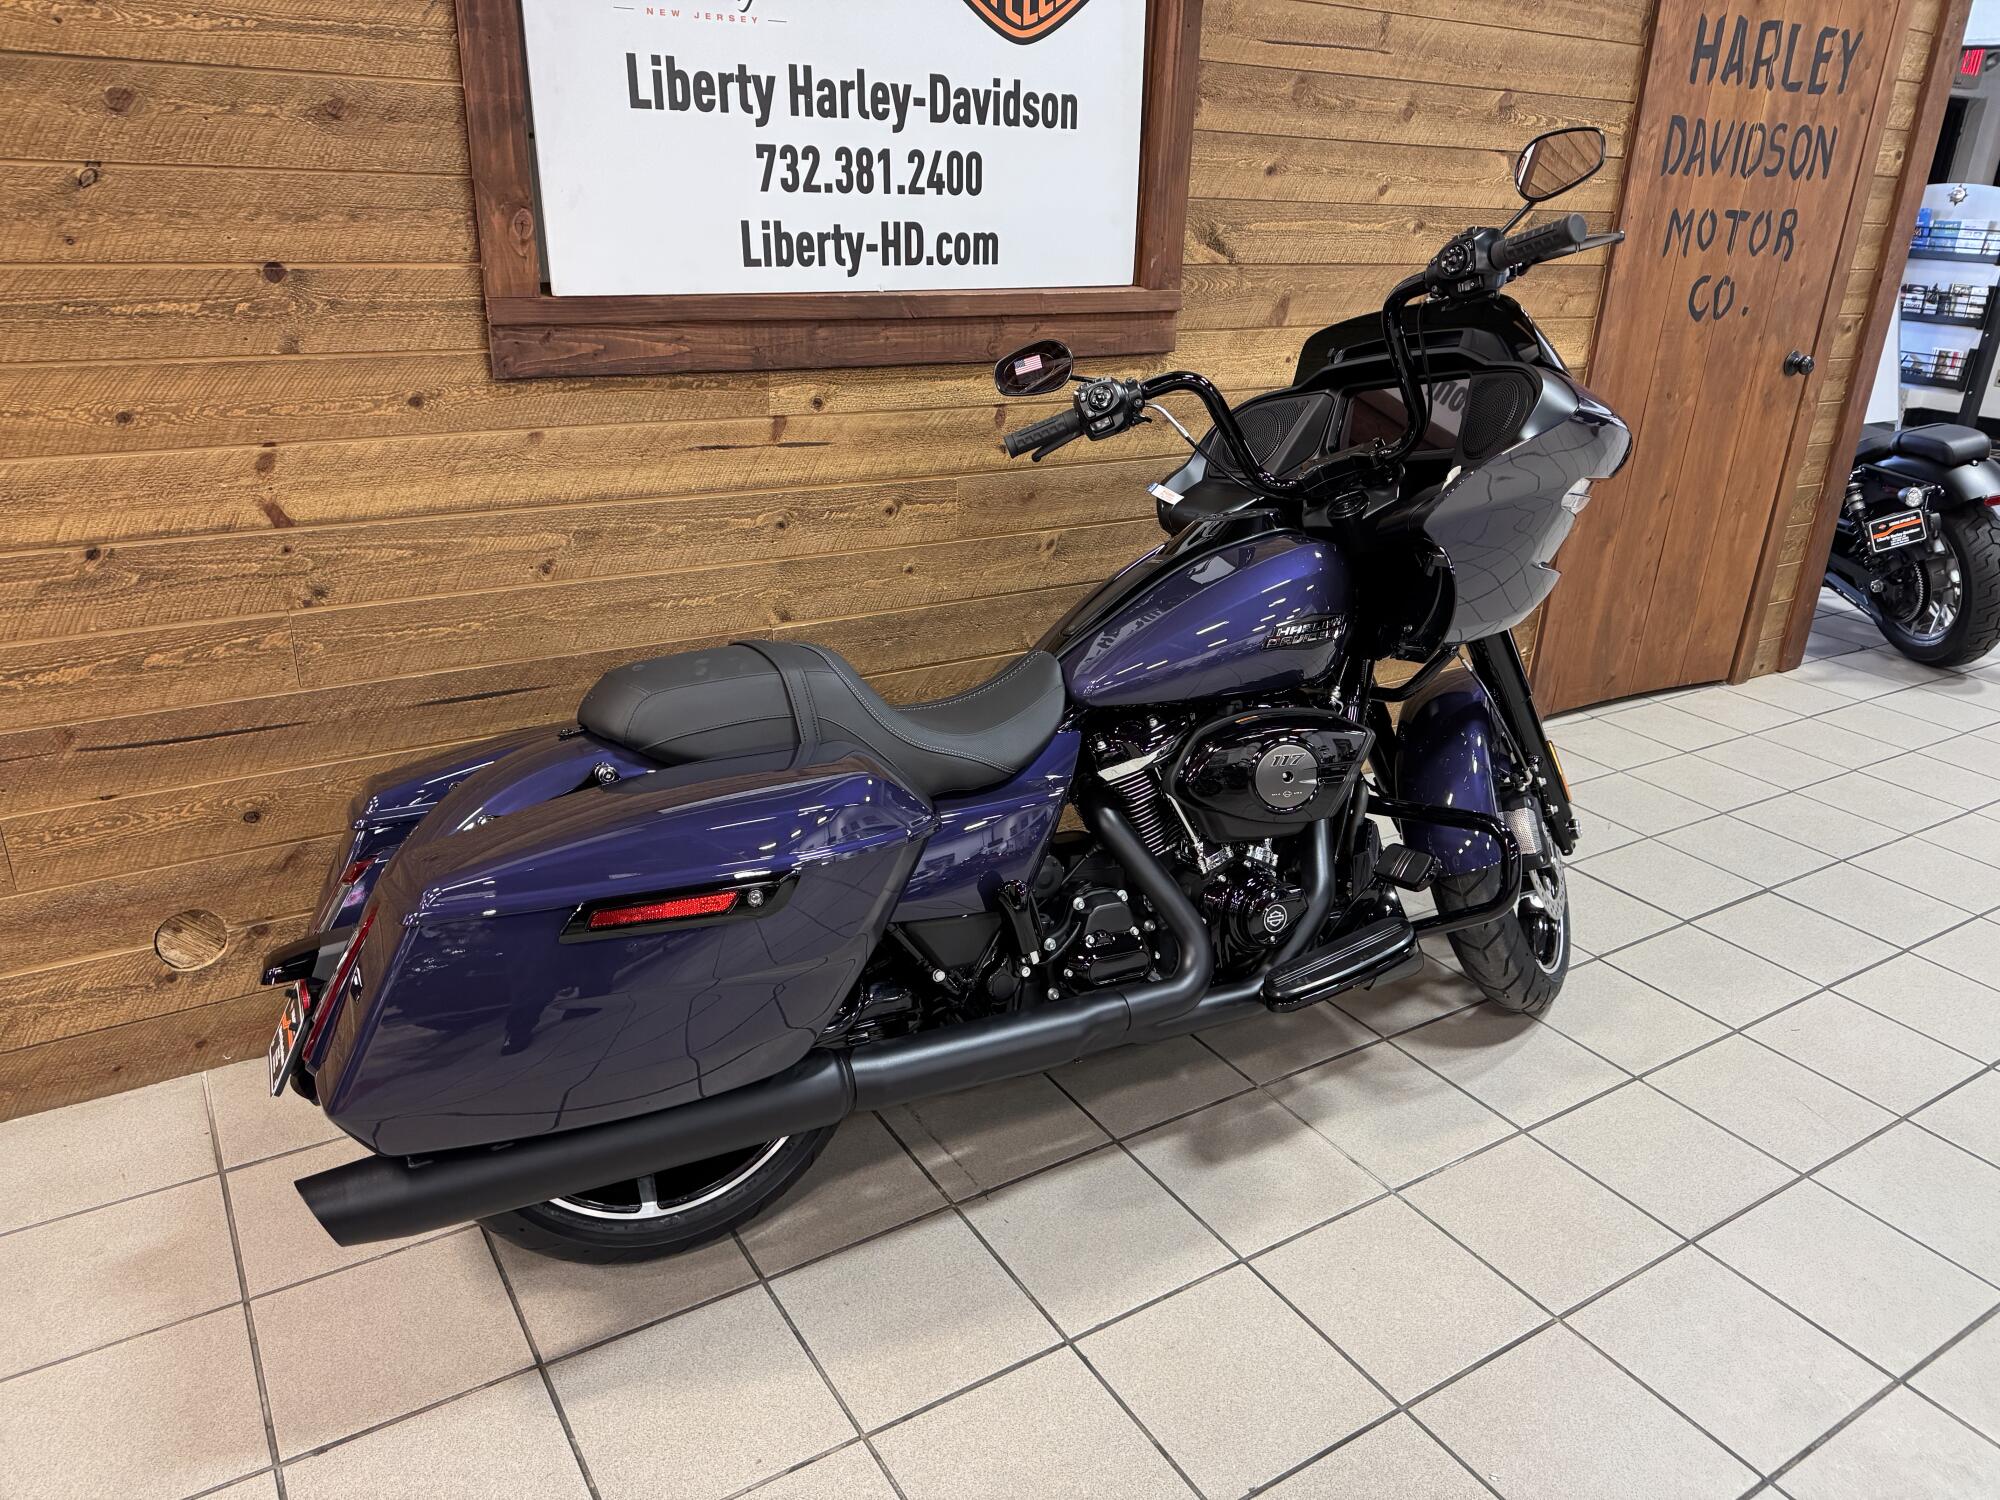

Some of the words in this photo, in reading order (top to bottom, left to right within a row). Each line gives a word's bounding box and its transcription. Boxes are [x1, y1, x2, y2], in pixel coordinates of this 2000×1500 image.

[646, 7, 680, 17] NEW
[693, 13, 758, 24] JERSEY
[1689, 12, 1864, 95] HARLEY
[1961, 48, 1984, 77] EXIT
[625, 52, 775, 128] Liberty
[788, 63, 1078, 134] Harley-Davidson
[755, 143, 983, 197] 732.381.2400
[1660, 114, 1838, 182] DAVIDSON
[740, 219, 999, 278] Liberty-HD.com
[1662, 207, 1798, 262] MOTOR
[1688, 274, 1749, 323] CO.
[1271, 752, 1306, 767] 117
